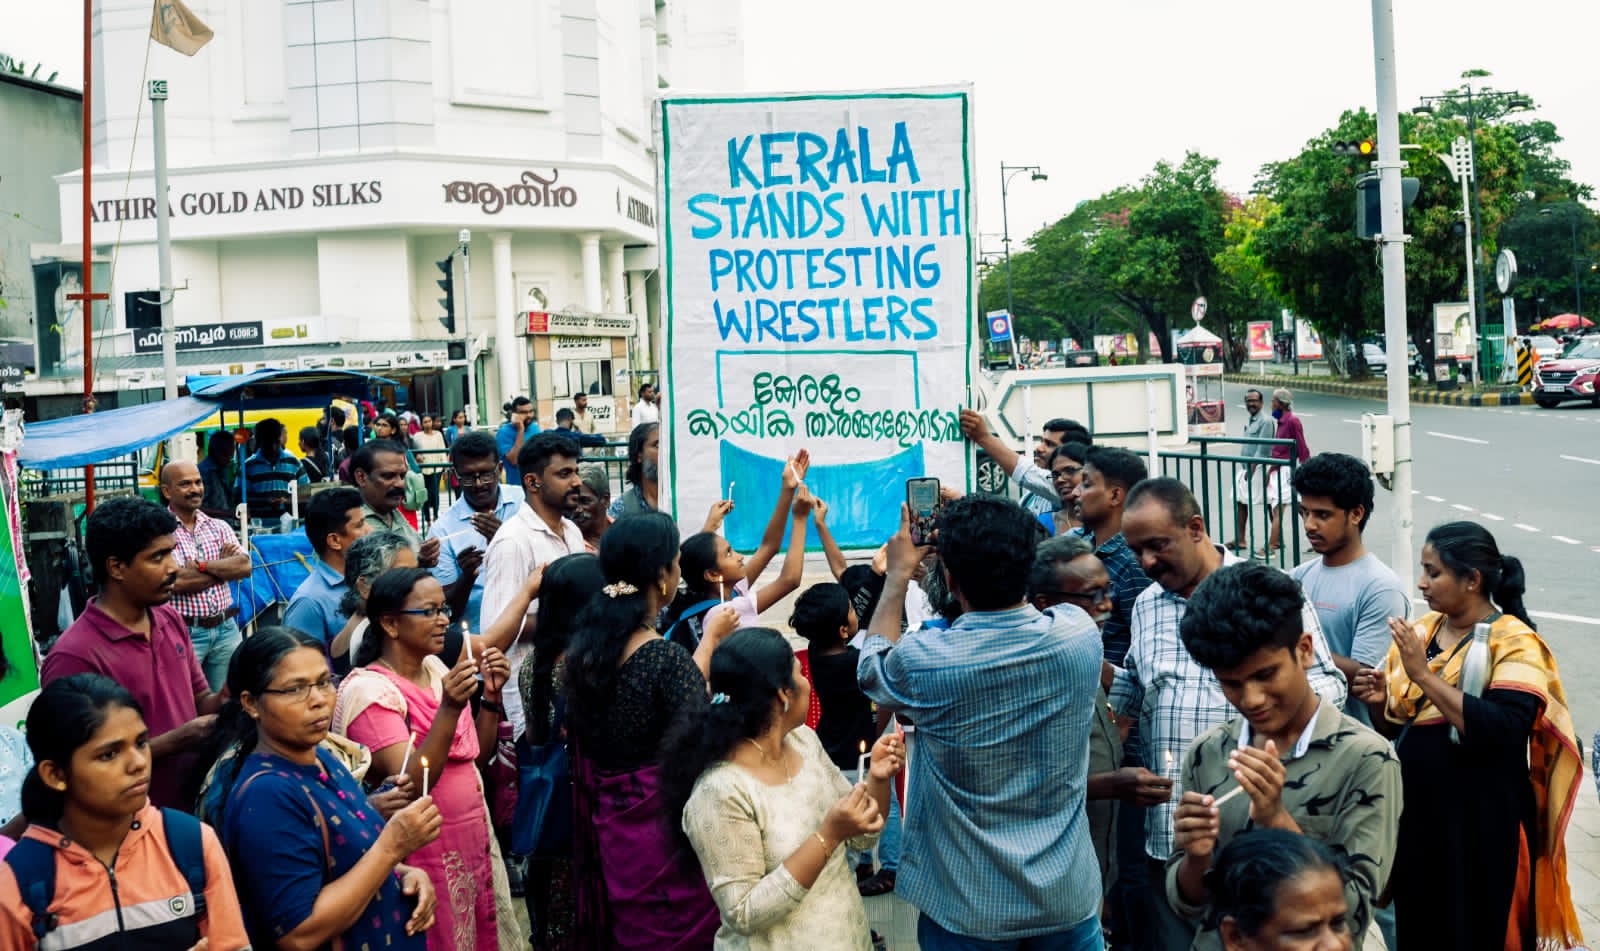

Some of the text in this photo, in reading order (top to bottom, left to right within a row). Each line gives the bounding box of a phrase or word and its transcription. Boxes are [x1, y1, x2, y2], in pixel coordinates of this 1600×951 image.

[727, 121, 921, 192] KERALA
[180, 191, 248, 216] GOLD
[254, 186, 304, 211] AND
[312, 180, 382, 207] SILKS
[442, 168, 577, 214] ആതിര
[627, 195, 655, 229] ATHIRA
[687, 188, 962, 240] STANDS WITH
[709, 243, 942, 293] PROTESTING
[713, 296, 939, 344] WRESTLERS
[753, 371, 861, 413] കേരളം
[687, 403, 964, 448] കായിക താരങ്ങളോടൊപ്പ
